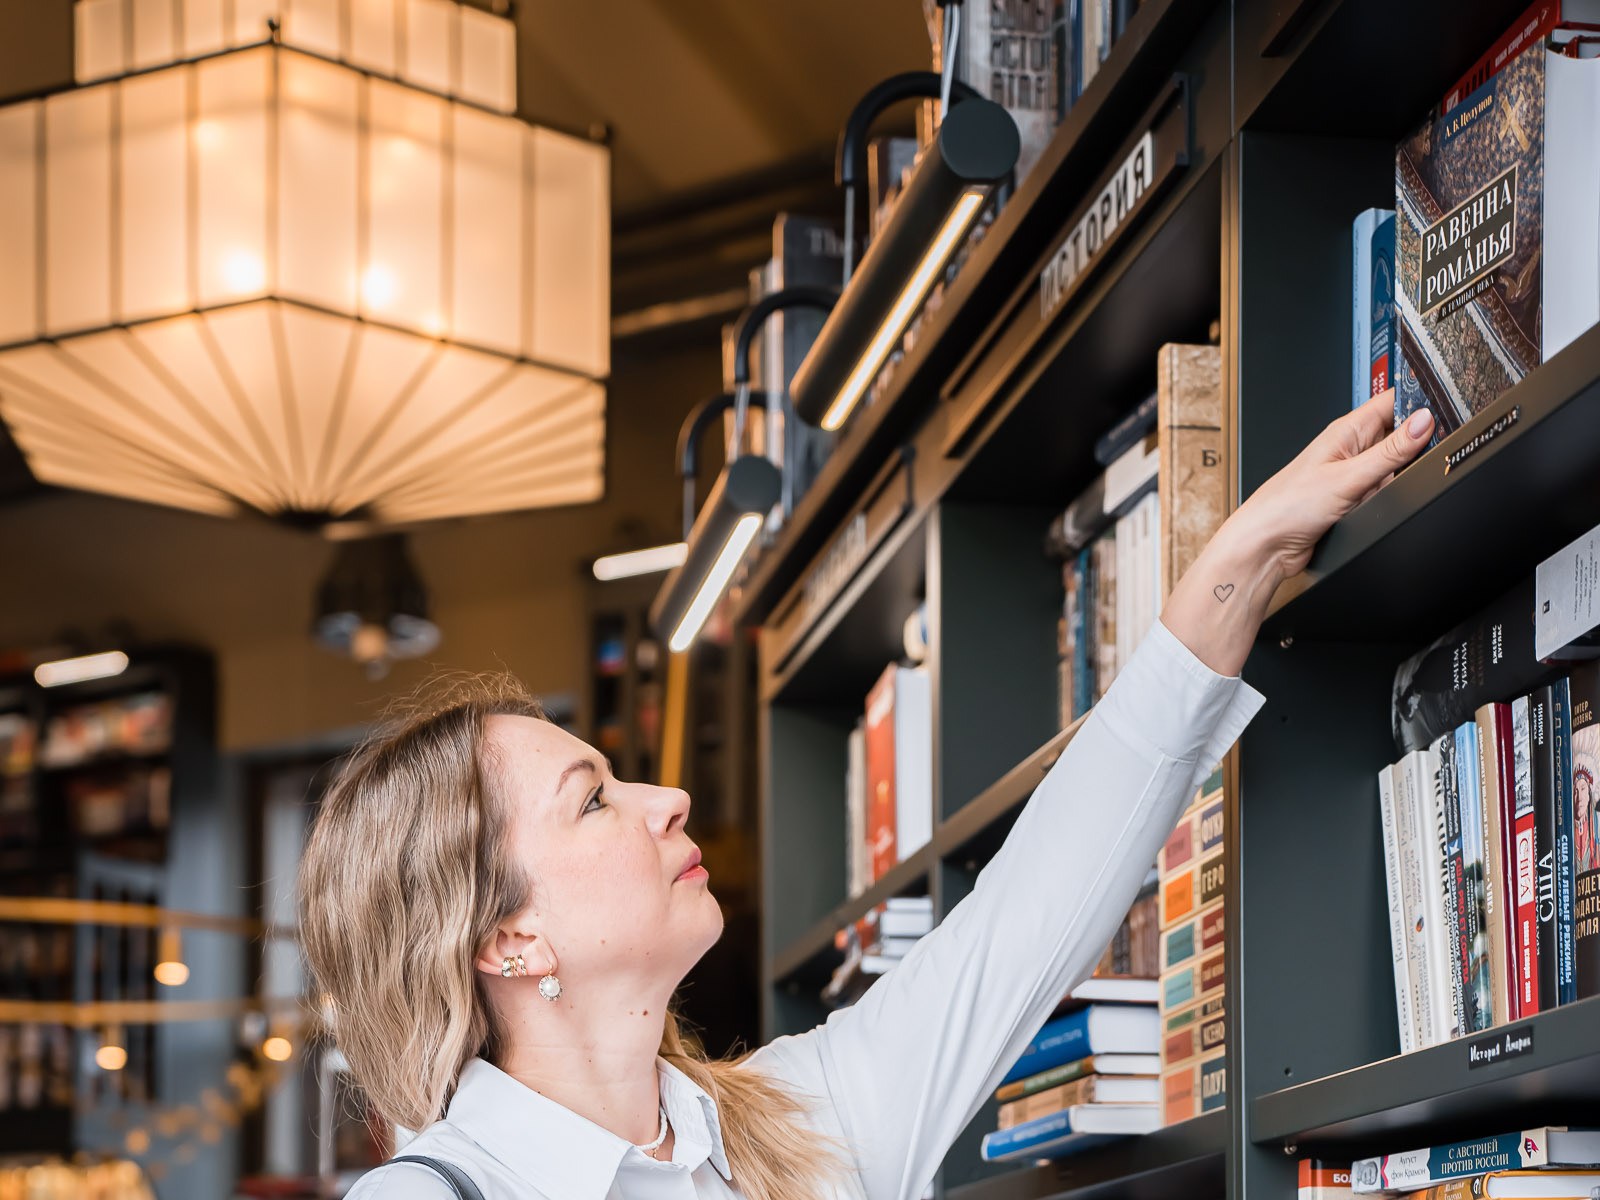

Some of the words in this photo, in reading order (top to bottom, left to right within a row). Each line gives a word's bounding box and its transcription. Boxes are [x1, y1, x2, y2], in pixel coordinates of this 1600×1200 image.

[1041, 142, 1147, 317] ИСТОРИЯ
[1426, 179, 1512, 262] РАВЕННА
[1426, 221, 1511, 304] РОМАНЬЯ
[1464, 236, 1471, 249] и
[1477, 275, 1494, 294] ВЕКА
[1387, 851, 1399, 912] Америки
[1448, 860, 1459, 907] Глазами
[1538, 849, 1553, 921] США
[1562, 866, 1568, 875] И
[1456, 889, 1464, 913] PRO
[1393, 919, 1404, 962] Когда
[1451, 910, 1462, 958] русских
[1458, 917, 1465, 930] ET
[1459, 935, 1469, 984] CONTRA
[1470, 1043, 1500, 1063] История
[1441, 1157, 1473, 1175] ПРОТИВ
[1474, 1153, 1509, 1172] РОССИИ
[1449, 1148, 1454, 1159] С
[1456, 1139, 1498, 1159] АВСТРИЕЙ
